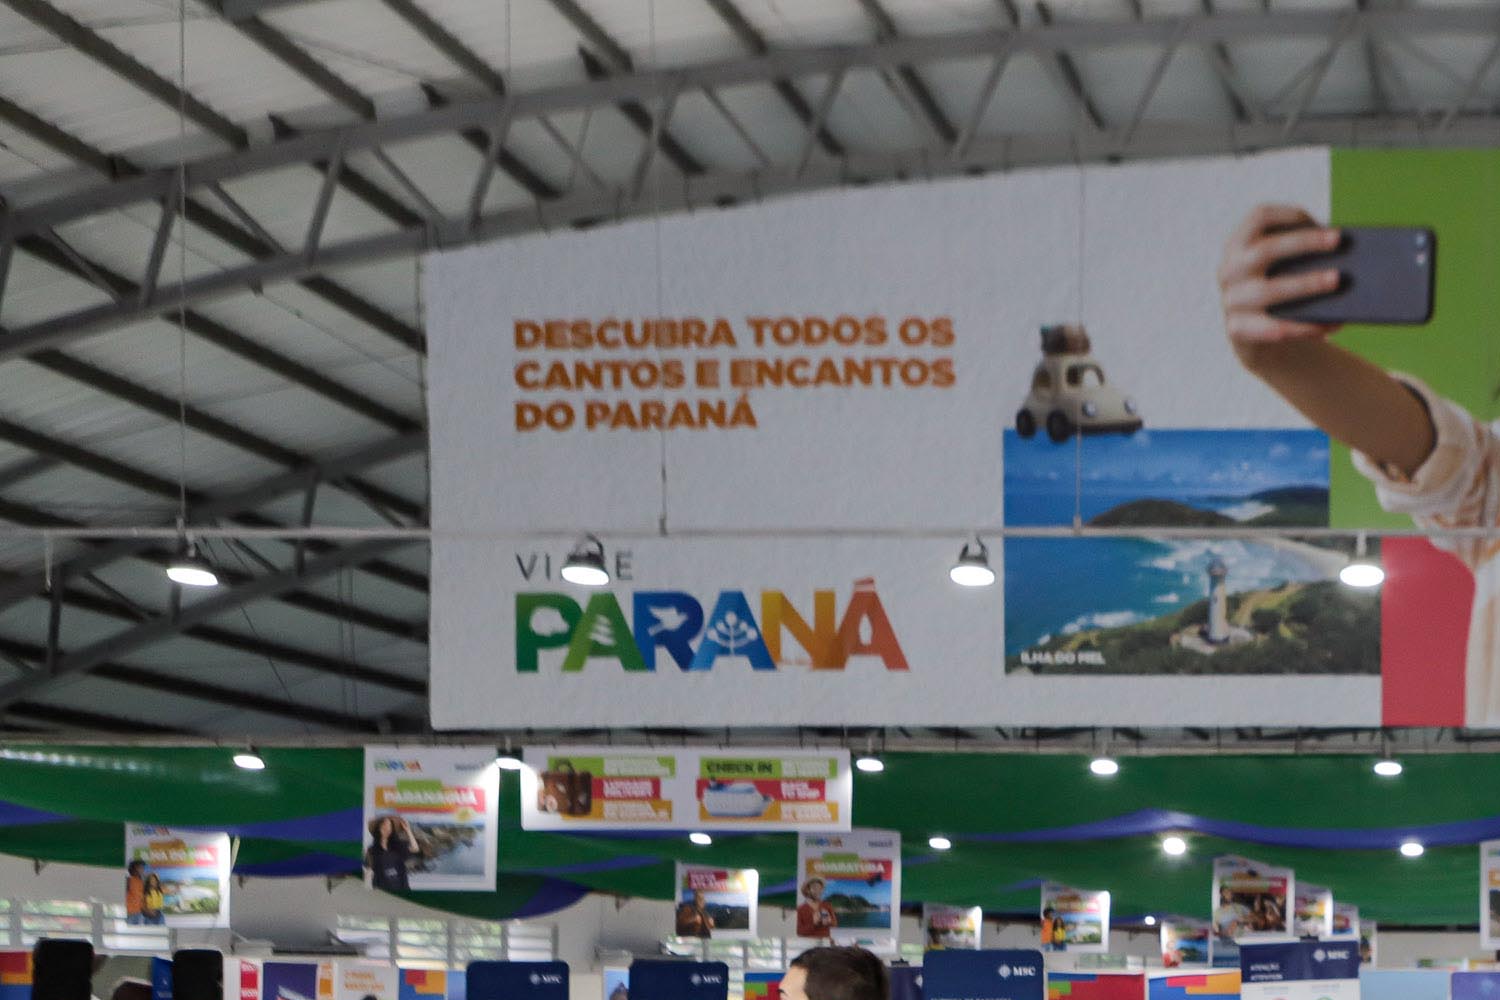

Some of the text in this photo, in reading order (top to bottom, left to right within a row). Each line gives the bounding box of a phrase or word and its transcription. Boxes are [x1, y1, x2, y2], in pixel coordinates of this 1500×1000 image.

[513, 314, 957, 351] DESCUBRA TODOS OS
[514, 357, 957, 391] CANTOS E ENCANTOS
[515, 392, 758, 432] DO PARANÁ
[516, 551, 634, 582] VIE
[514, 576, 911, 673] PARANÁ
[1012, 966, 1036, 977] MSC
